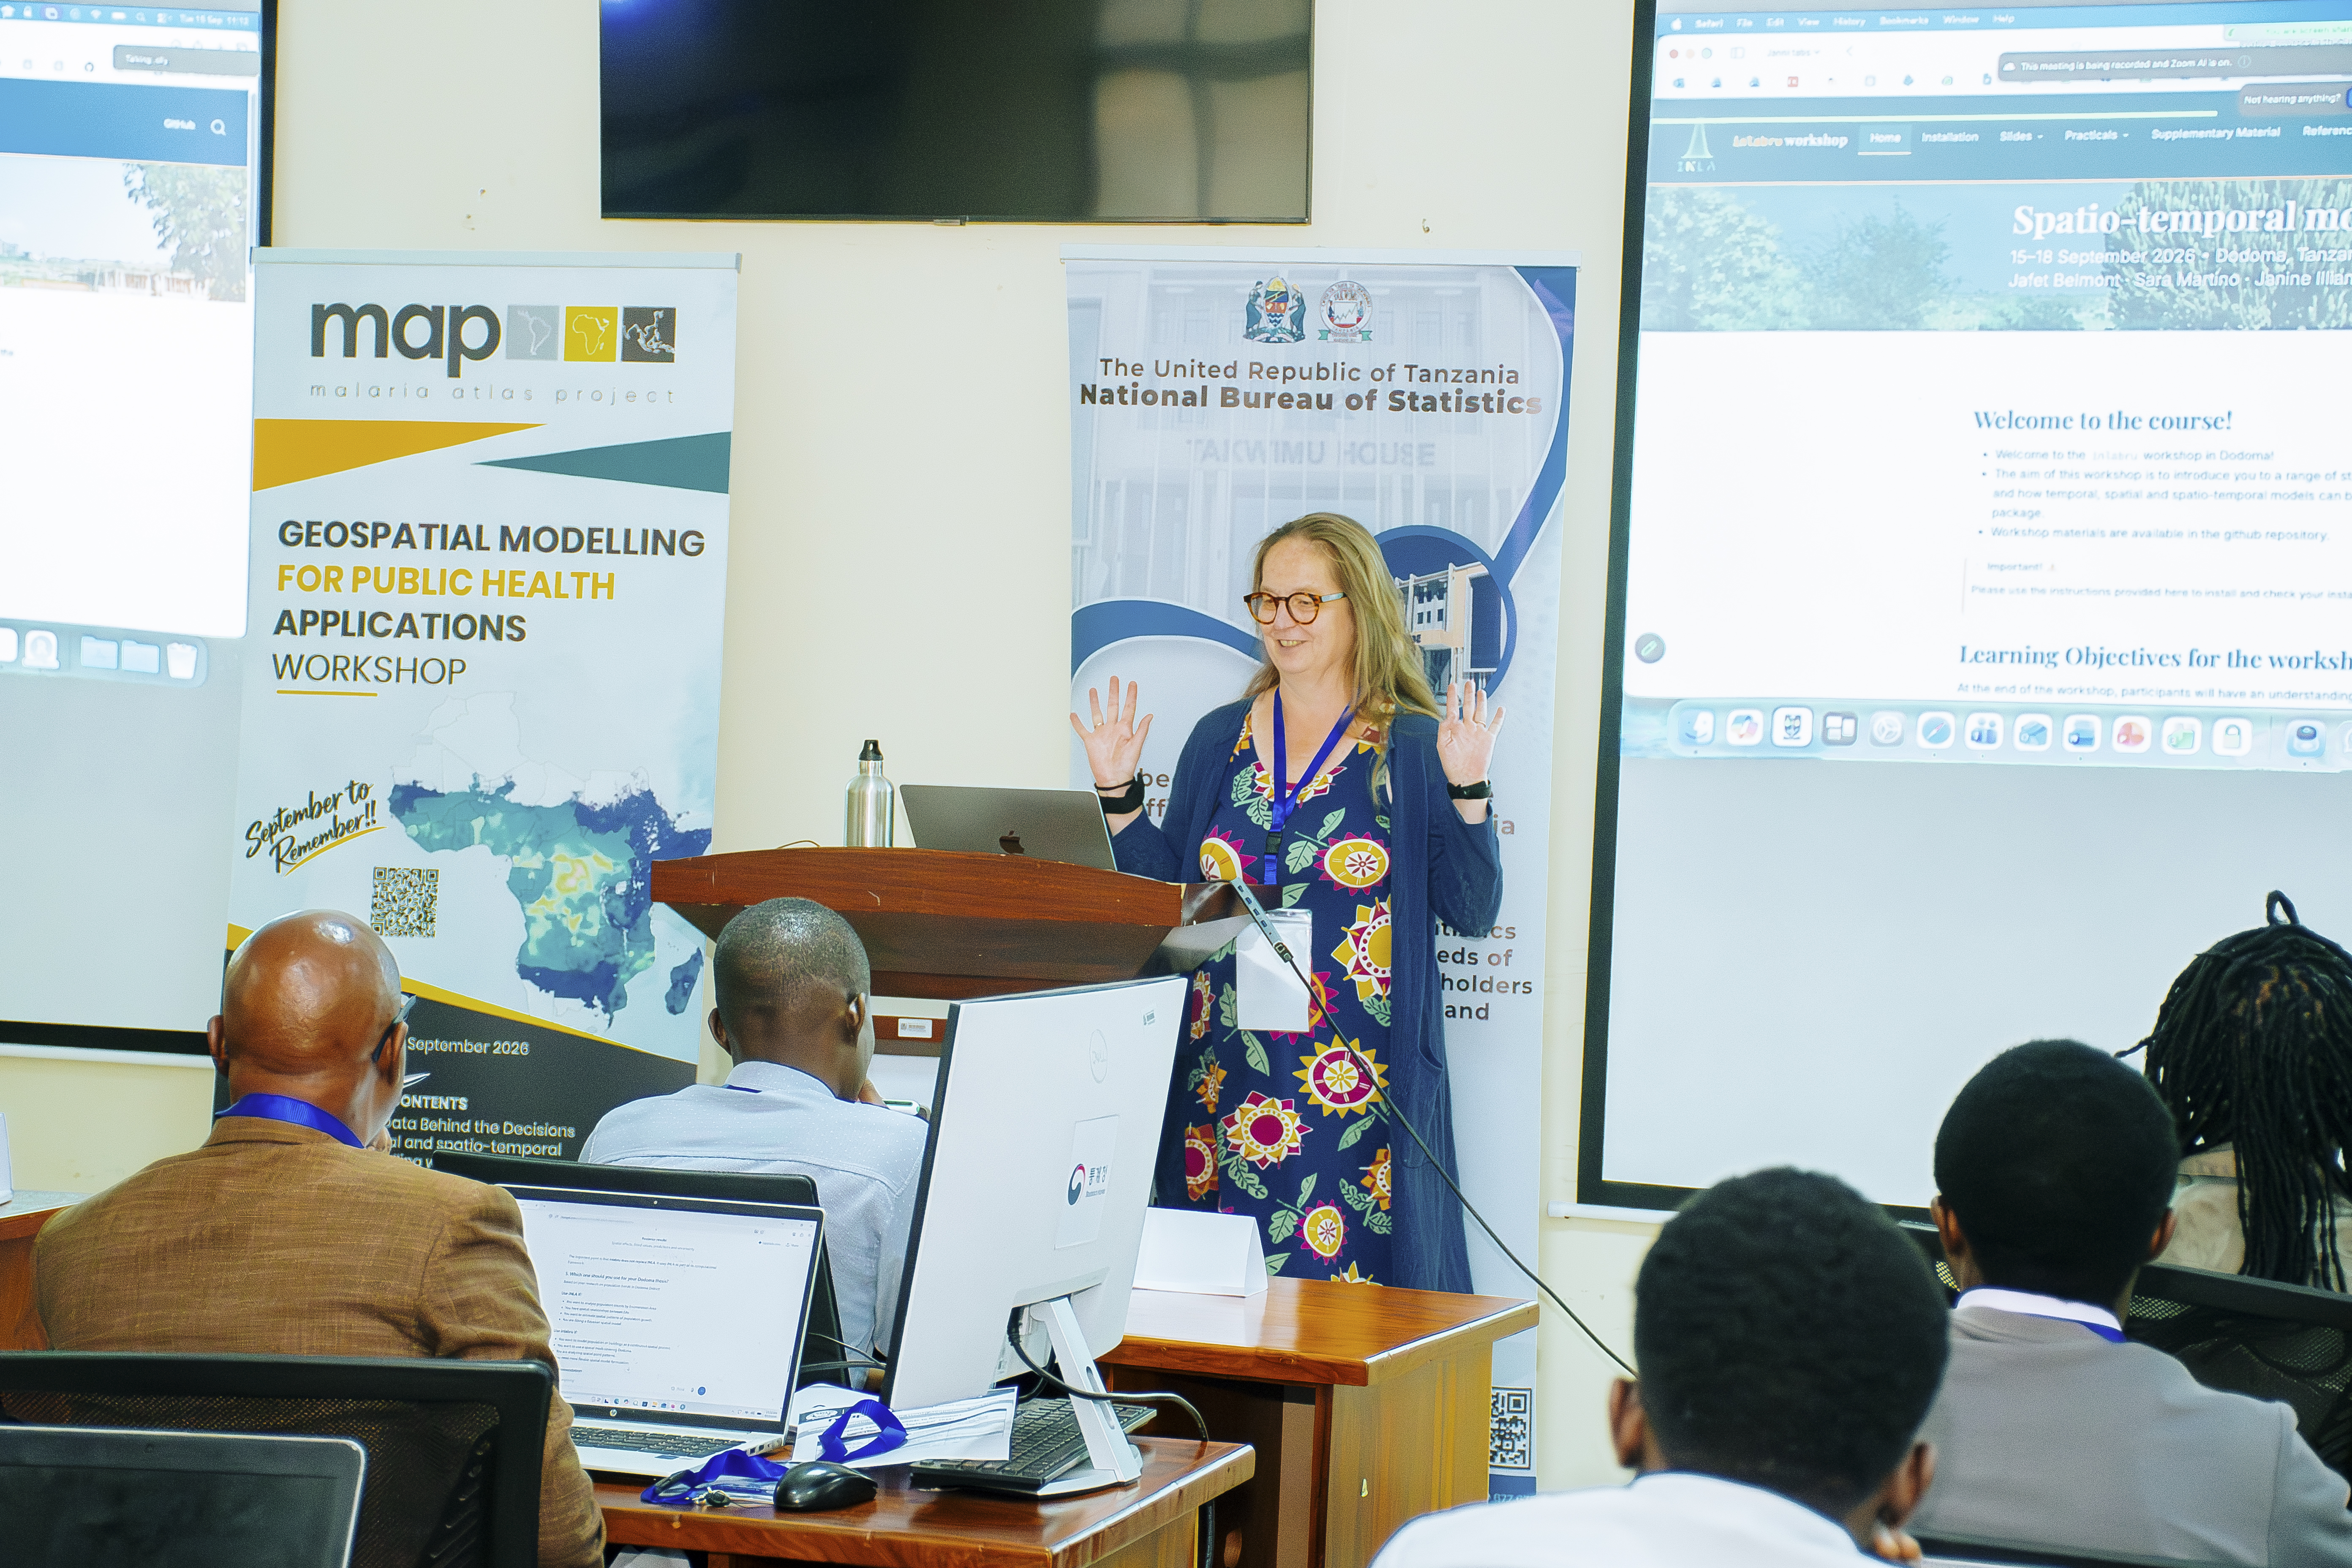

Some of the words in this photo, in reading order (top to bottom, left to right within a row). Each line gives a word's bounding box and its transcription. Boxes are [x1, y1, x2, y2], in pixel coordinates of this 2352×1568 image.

[2244, 96, 2261, 104] Not
[2263, 95, 2297, 104] hearing
[2298, 93, 2341, 104] anything?
[1784, 133, 1848, 148] workshop
[1870, 133, 1901, 143] Home
[1922, 132, 1979, 142] Installation
[2000, 131, 2032, 141] Slides
[2065, 129, 2118, 140] Practicals
[2151, 128, 2234, 141] Supplementary
[2235, 126, 2281, 137] Material
[2013, 200, 2296, 240] Spatio-temporal
[2058, 248, 2147, 267] September
[2152, 248, 2195, 263] 2026
[2009, 274, 2048, 287] Jafet
[2054, 272, 2122, 287] Belmont
[2133, 272, 2173, 286] Sara
[2254, 271, 2311, 286] Janine
[311, 302, 501, 378] map
[1100, 358, 1144, 376] The
[1154, 358, 1237, 378] United
[1249, 361, 1361, 384] Republic
[1370, 363, 1396, 382] of
[1404, 364, 1519, 385] Tanzania
[310, 382, 428, 398] malaria
[452, 384, 532, 401] atlas
[555, 387, 673, 406] project
[1081, 381, 1208, 407] National
[1220, 384, 1333, 410] Bureau
[1345, 388, 1377, 411] of
[1388, 389, 1542, 414] Statistics
[1974, 410, 2073, 429] Welcome
[2081, 413, 2101, 429] to
[2109, 410, 2142, 430] the
[2149, 410, 2232, 430] course!
[1995, 449, 2049, 459] Welcome
[2053, 450, 2064, 459] to
[2067, 450, 2086, 459] the
[2143, 451, 2202, 462] workshop
[2205, 452, 2216, 460] in
[2220, 450, 2274, 460] Dodoma!
[1996, 468, 2016, 478] The
[2020, 471, 2040, 479] aim
[2044, 468, 2056, 479] of
[2059, 470, 2080, 479] this
[2084, 470, 2142, 481] workshop
[2146, 472, 2155, 480] is
[2158, 471, 2170, 479] to
[2174, 470, 2230, 480] introduce
[2234, 472, 2257, 482] you
[2259, 471, 2271, 480] to
[2286, 472, 2321, 483] range
[2324, 470, 2337, 481] of
[1993, 489, 2014, 498] and
[2017, 489, 2042, 498] how
[2105, 490, 2142, 500] spatial
[2146, 490, 2169, 499] and
[2172, 490, 2267, 501] spatio-temporal
[2270, 490, 2314, 501] models
[2319, 492, 2341, 501] can
[278, 520, 490, 551] GEOSPATIAL
[499, 525, 704, 557] MODELLING
[1991, 527, 2050, 538] Workshop
[2053, 528, 2106, 538] materials
[2110, 529, 2128, 537] are
[2132, 528, 2183, 538] available
[2201, 529, 2220, 539] the
[2224, 530, 2262, 541] github
[278, 564, 343, 592] FOR
[351, 566, 473, 596] PUBLIC
[482, 569, 615, 599] HEALTH
[273, 609, 525, 642] APPLICATIONS
[1960, 645, 2059, 667] Learning
[2066, 646, 2180, 669] Objectives
[2189, 648, 2221, 667] for
[2227, 649, 2262, 668] the
[272, 653, 466, 684] WORKSHOP
[1957, 683, 1969, 692] At
[1972, 683, 1990, 692] the
[1994, 685, 2016, 694] end
[2020, 684, 2031, 694] of
[2034, 686, 2053, 694] the
[2121, 688, 2191, 698] participants
[2195, 688, 2214, 697] will
[2218, 689, 2246, 698] have
[2250, 690, 2265, 699] an
[245, 790, 343, 859] September
[346, 780, 374, 805] to
[269, 800, 376, 874] Remember!!
[1437, 947, 1478, 966] eds
[1488, 949, 1513, 966] of
[1445, 1003, 1489, 1020] and
[407, 1037, 491, 1055] September
[493, 1040, 530, 1056] 2026
[401, 1094, 468, 1111] ONTENTS
[420, 1117, 470, 1133] Behind
[474, 1119, 501, 1134] the
[503, 1120, 576, 1138] Decisions
[404, 1136, 434, 1149] and
